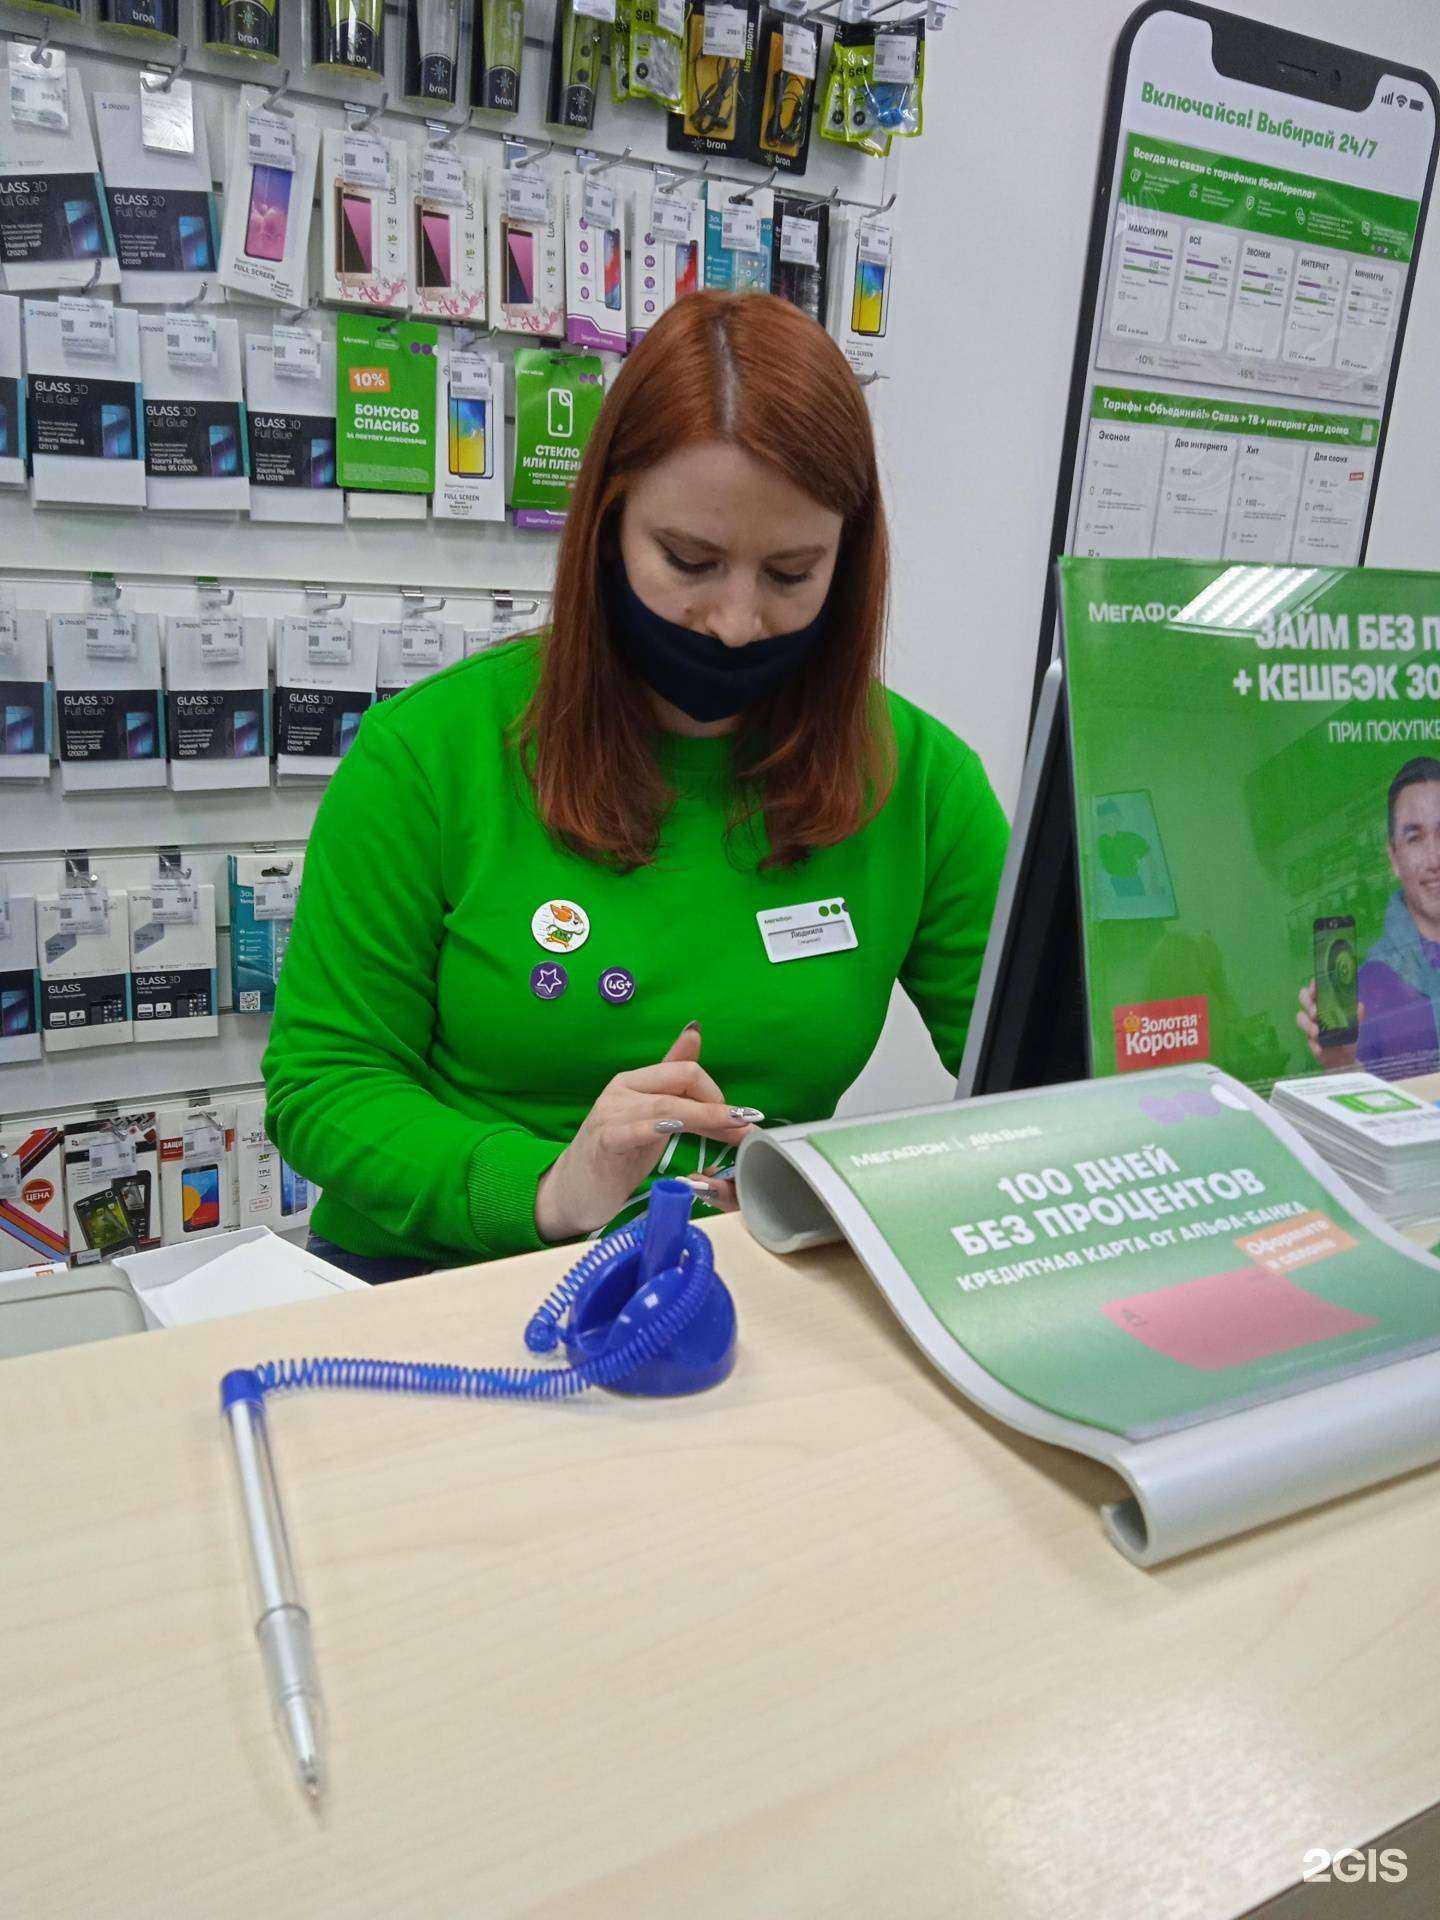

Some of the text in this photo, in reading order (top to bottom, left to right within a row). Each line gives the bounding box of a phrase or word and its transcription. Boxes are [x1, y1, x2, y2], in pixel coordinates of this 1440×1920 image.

[132, 9, 155, 24] bron
[238, 32, 259, 45] bron
[743, 21, 755, 73] Headphone
[429, 82, 449, 95] bron
[494, 95, 513, 107] bron
[569, 112, 588, 123] bron
[1141, 81, 1378, 159] Включайся! Выбирай 24/7
[706, 138, 727, 150] bron
[775, 156, 791, 167] bron
[1133, 147, 1167, 168] Всегда
[1167, 156, 1178, 170] на
[1180, 158, 1206, 178] связи
[1213, 168, 1257, 189] тарифами
[0, 181, 47, 193] LASS 3D
[0, 196, 14, 207] ull
[113, 194, 166, 206] GLASS 3D
[115, 207, 157, 217] Full Glue
[1128, 223, 1169, 241] МАКСИМУМ
[1246, 247, 1271, 261] ЗВОНКИ
[1300, 258, 1331, 272] ИНТЕРНЕТ
[250, 268, 276, 282] SCREEN
[1354, 269, 1385, 283] МИНИМУМ
[354, 371, 386, 388] 10%
[34, 381, 89, 395] GLASS 3D
[35, 392, 79, 406] Full Glue
[146, 405, 197, 417] GLASS 3D
[354, 403, 420, 421] БОНУСОВ
[1103, 397, 1142, 416] Тарифы
[1212, 410, 1239, 424] Связь
[1248, 414, 1260, 426] ТВ
[1266, 418, 1306, 433] интернет
[1307, 422, 1324, 435] для
[1325, 424, 1350, 437] дома
[146, 418, 189, 428] Full Glue
[254, 417, 286, 429] GLASS
[354, 417, 420, 435] СПАСИБО
[255, 428, 293, 440] Full Glue
[1098, 430, 1131, 443] Эконом
[535, 444, 580, 460] СТЕКЛО
[1174, 437, 1228, 454] Два интернета
[1246, 445, 1260, 456] Хит
[522, 456, 583, 472] ИЛИ ПЛЕН
[1313, 451, 1328, 464] Для
[1088, 601, 1182, 624] МЕГАФО
[1256, 608, 1349, 651] ЗАЙМ
[1359, 613, 1415, 651] БЕЗ
[1233, 668, 1253, 696] +
[1258, 662, 1399, 702] КЕШБЭК
[64, 695, 114, 706] GLASS 3D
[176, 695, 224, 706] GLASS 3D
[289, 693, 334, 705] GLASS 3D
[64, 706, 106, 716] Full Glue
[177, 706, 216, 716] Full Glue
[289, 703, 326, 715] Full Glue
[1328, 719, 1362, 744] ПРИ
[136, 975, 181, 986] GLASS 3D
[607, 979, 633, 991] 4G+
[48, 983, 81, 995] GLASS
[1140, 1014, 1198, 1034] Золотая
[1125, 1027, 1199, 1057] Корона
[163, 1141, 184, 1151] ЗАЩИ
[997, 1143, 1181, 1205] 100 ДНЕЙ
[26, 1191, 50, 1202] ЦЕНА
[950, 1168, 1266, 1257] БЕЗ ПРОЦЕНТОВ
[956, 1200, 1310, 1292] КРЕДИТНАЯ КАРТА ОТ АЛЬФА-БАНКА
